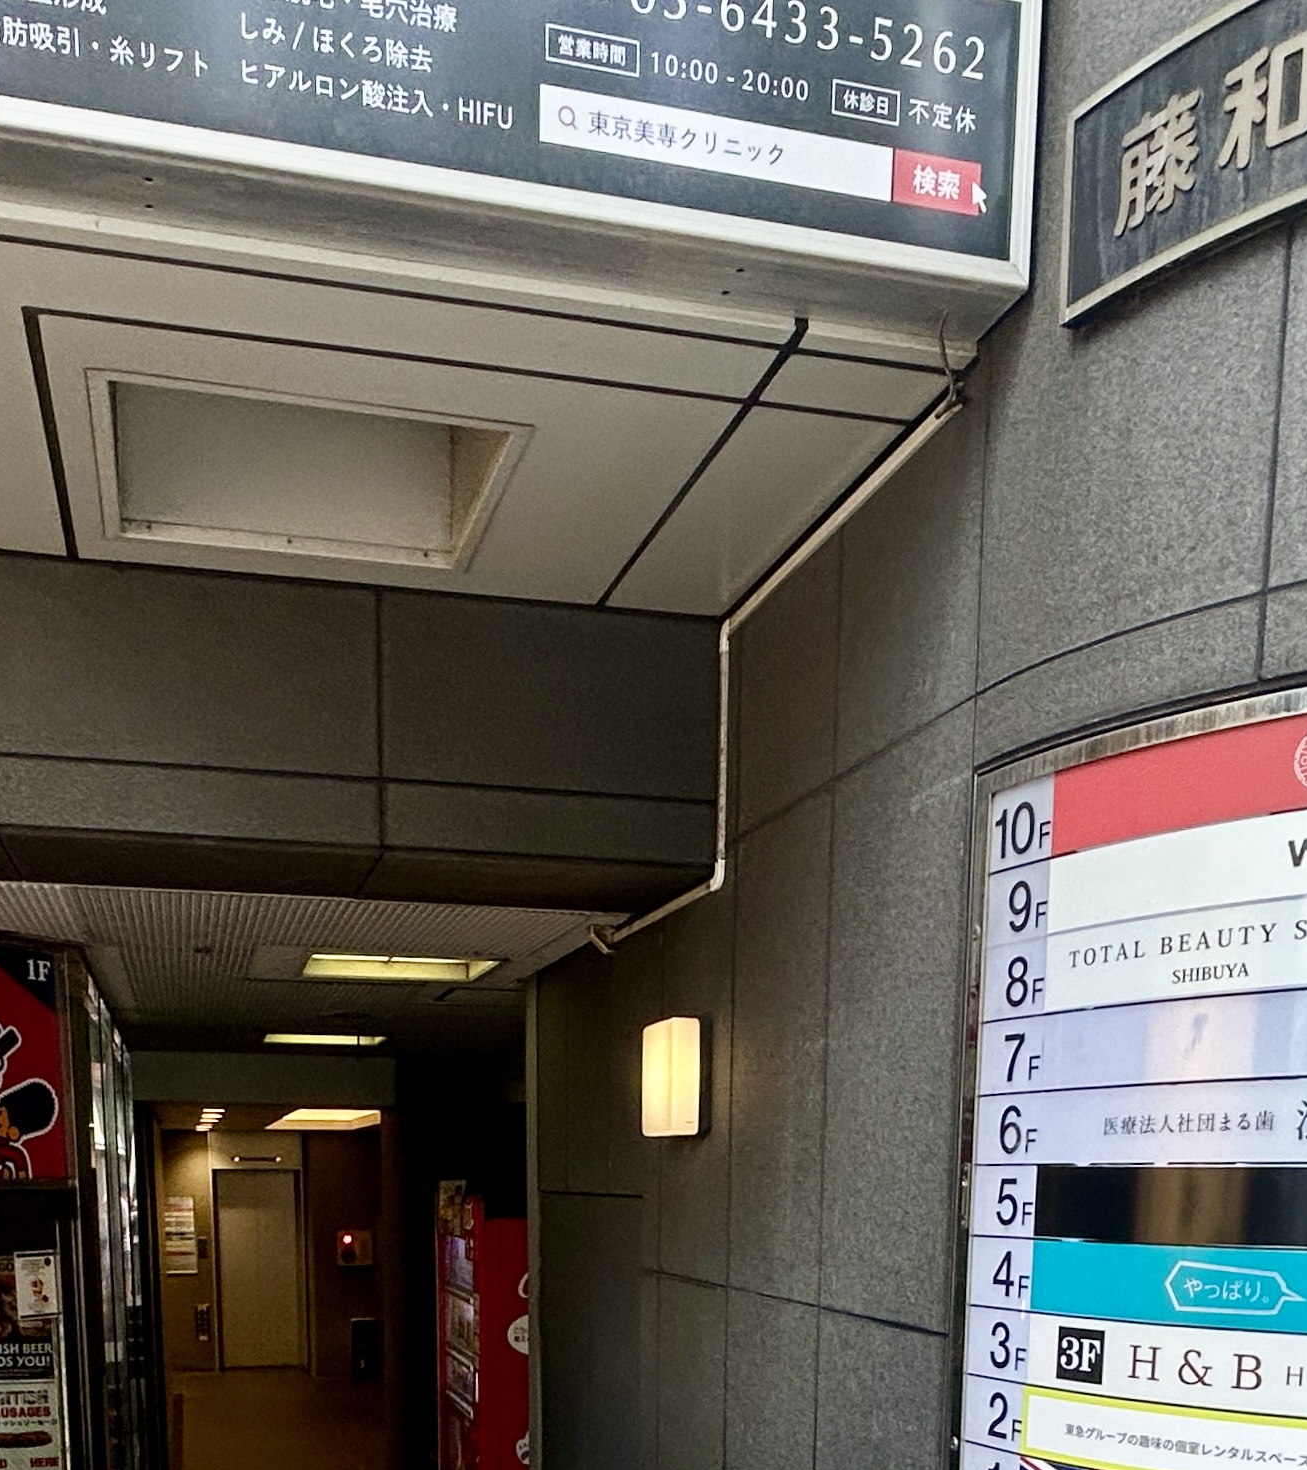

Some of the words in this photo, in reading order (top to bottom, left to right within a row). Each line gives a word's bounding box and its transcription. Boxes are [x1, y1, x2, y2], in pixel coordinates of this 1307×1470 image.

[557, 34, 627, 66] 営業時間
[651, 52, 719, 85] 10:00
[742, 69, 810, 101] 20:00
[843, 90, 891, 116] 休診日
[908, 98, 978, 135] 不定休
[587, 110, 785, 167] 東京美専クリニック
[912, 164, 961, 200] 検索
[994, 801, 1051, 860] 10F
[1008, 880, 1048, 933] 9F
[26, 957, 52, 982] 1F
[1068, 940, 1147, 970] TOTAL
[1159, 922, 1278, 956] BEAUTY
[1004, 956, 1045, 1008] 8F
[1171, 962, 1250, 986] SHIBUYA
[1003, 1032, 1042, 1083] 7F
[998, 1104, 1038, 1155] 6F
[995, 1177, 1034, 1227] 5F
[992, 1250, 1031, 1299] 4F
[16, 1355, 51, 1367] YOU!
[22, 1342, 54, 1355] BEER
[989, 1321, 1028, 1372] 3F
[1059, 1335, 1102, 1374] 3F
[987, 1391, 1023, 1442] 2F
